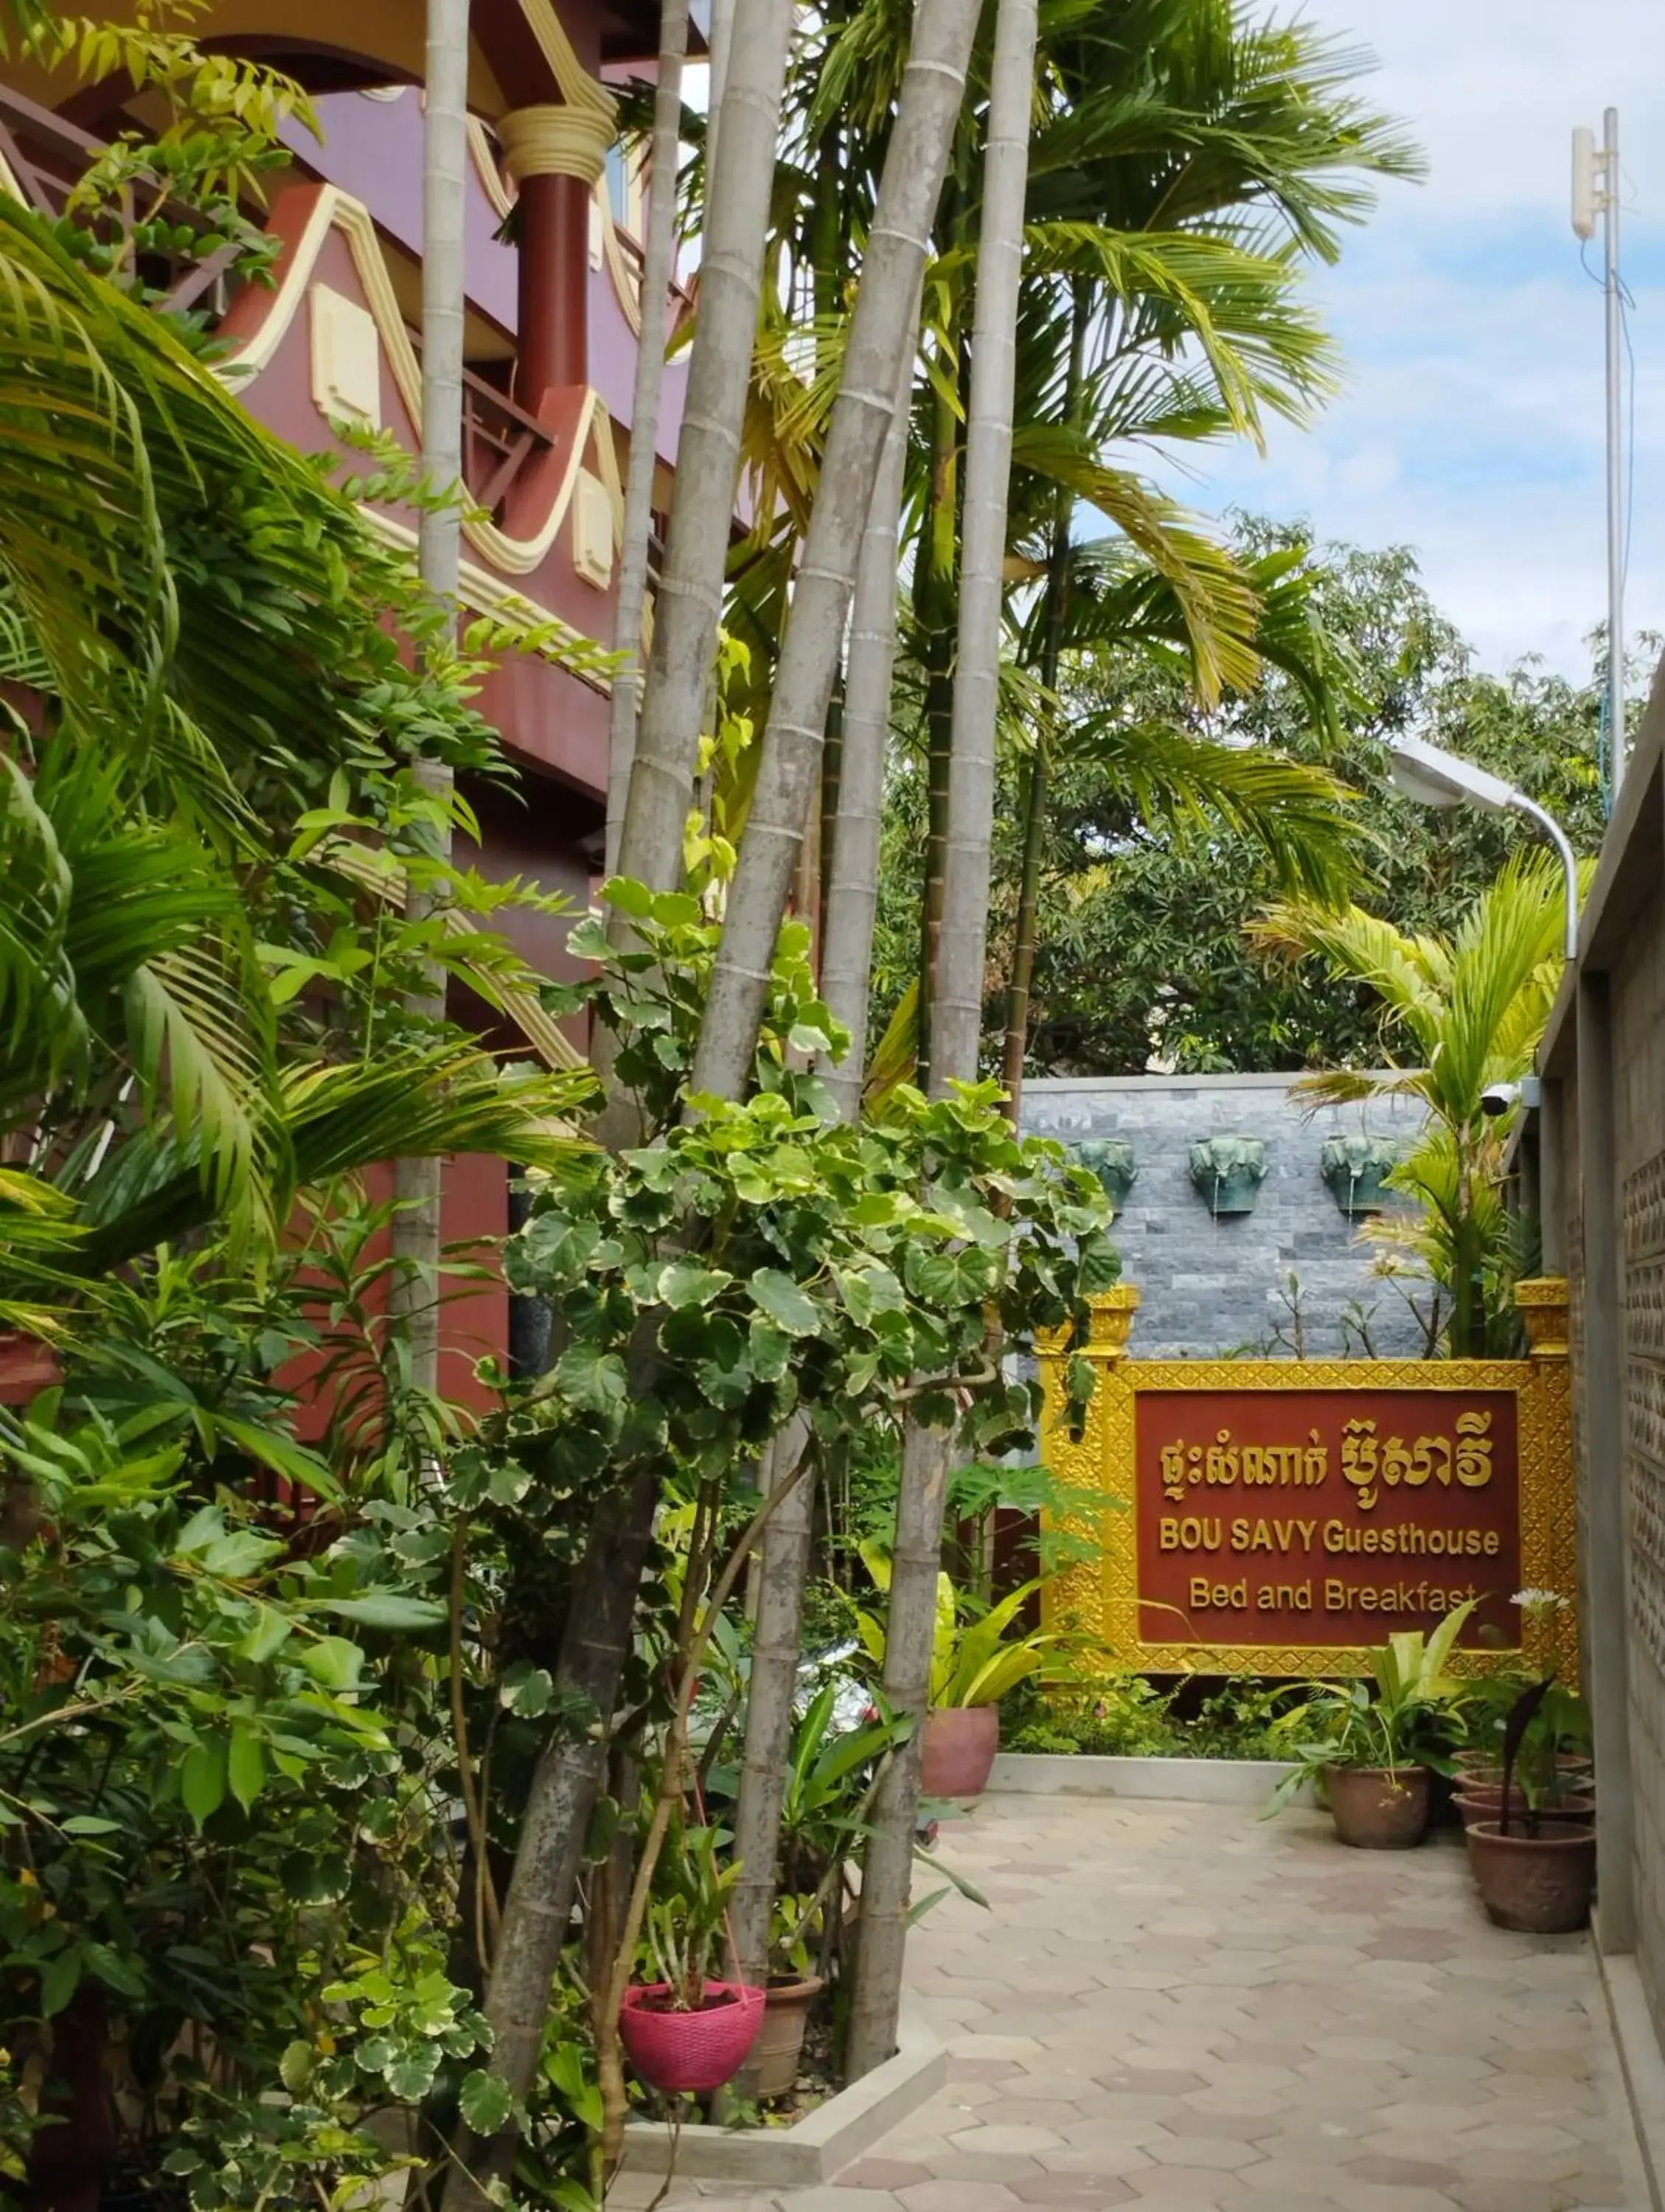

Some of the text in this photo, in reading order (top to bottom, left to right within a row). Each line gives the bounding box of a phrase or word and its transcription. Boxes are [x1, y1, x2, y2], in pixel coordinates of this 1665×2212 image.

[1159, 1517, 1500, 1556] BOU SAVY Guesthouse
[1189, 1577, 1248, 1610] Bed
[1256, 1579, 1313, 1610] and
